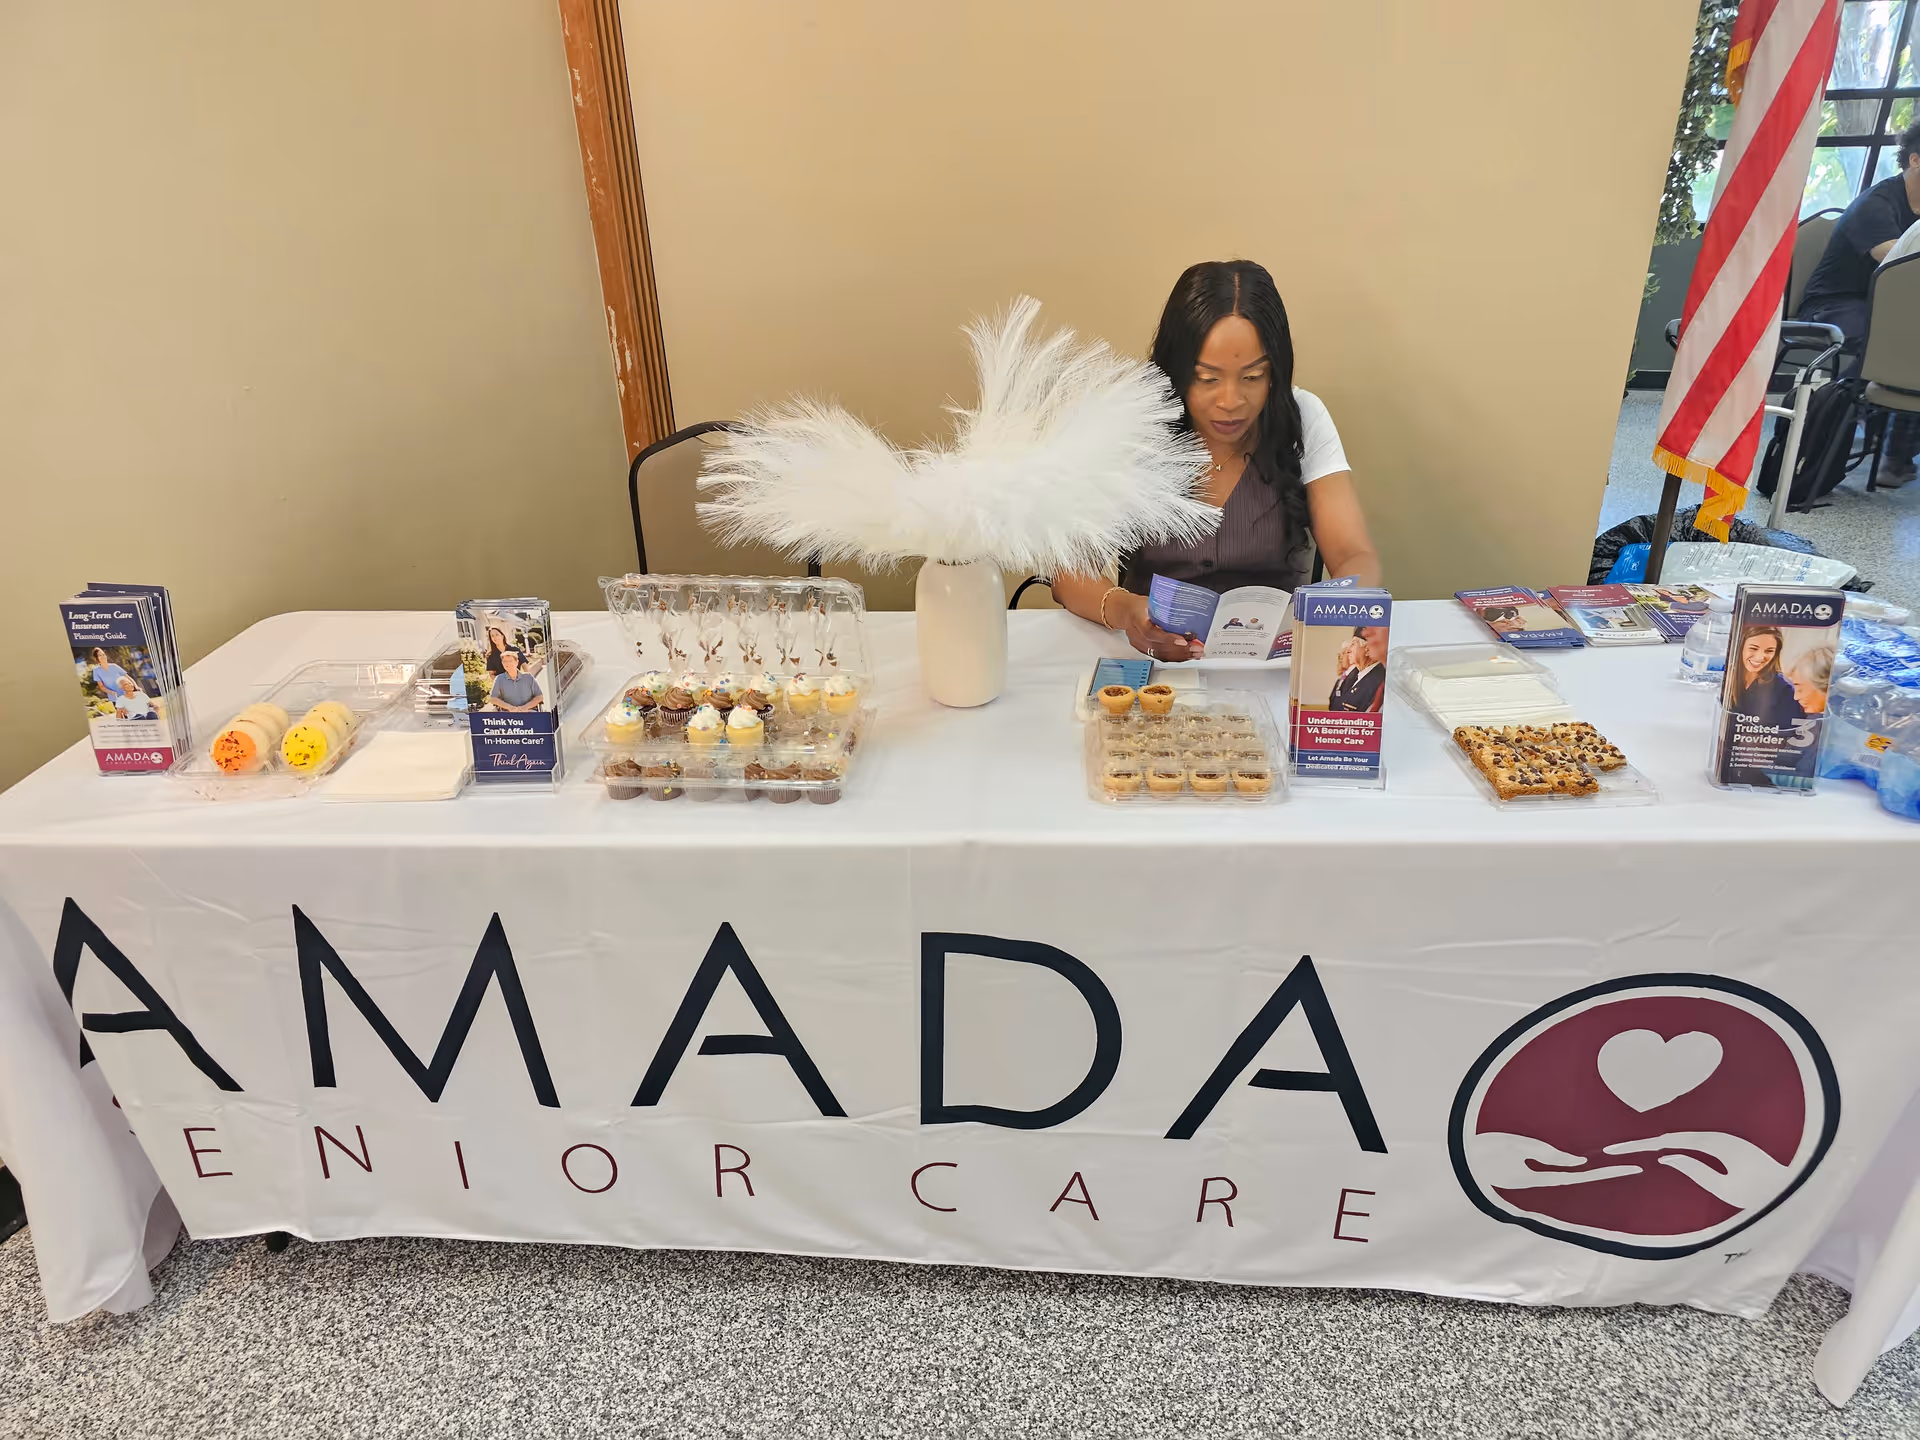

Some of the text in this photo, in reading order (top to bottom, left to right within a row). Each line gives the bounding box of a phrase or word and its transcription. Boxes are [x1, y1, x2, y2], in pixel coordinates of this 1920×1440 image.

[1313, 604, 1368, 614] AMADA
[1751, 602, 1813, 614] AMADA
[68, 611, 133, 621] Long-Term Care
[74, 632, 105, 641] Planning
[1307, 717, 1375, 727] Understanding
[1736, 713, 1760, 723] One
[1321, 727, 1360, 735] Benefits
[1361, 728, 1375, 736] for
[1735, 723, 1779, 734] Trusted
[1786, 718, 1817, 747] 3
[1315, 736, 1365, 745] Home Care
[1733, 734, 1784, 745] Provider
[105, 752, 150, 762] AMADA
[53, 896, 1389, 1154] AMADA
[112, 1094, 1376, 1244] ENIOR CARE
